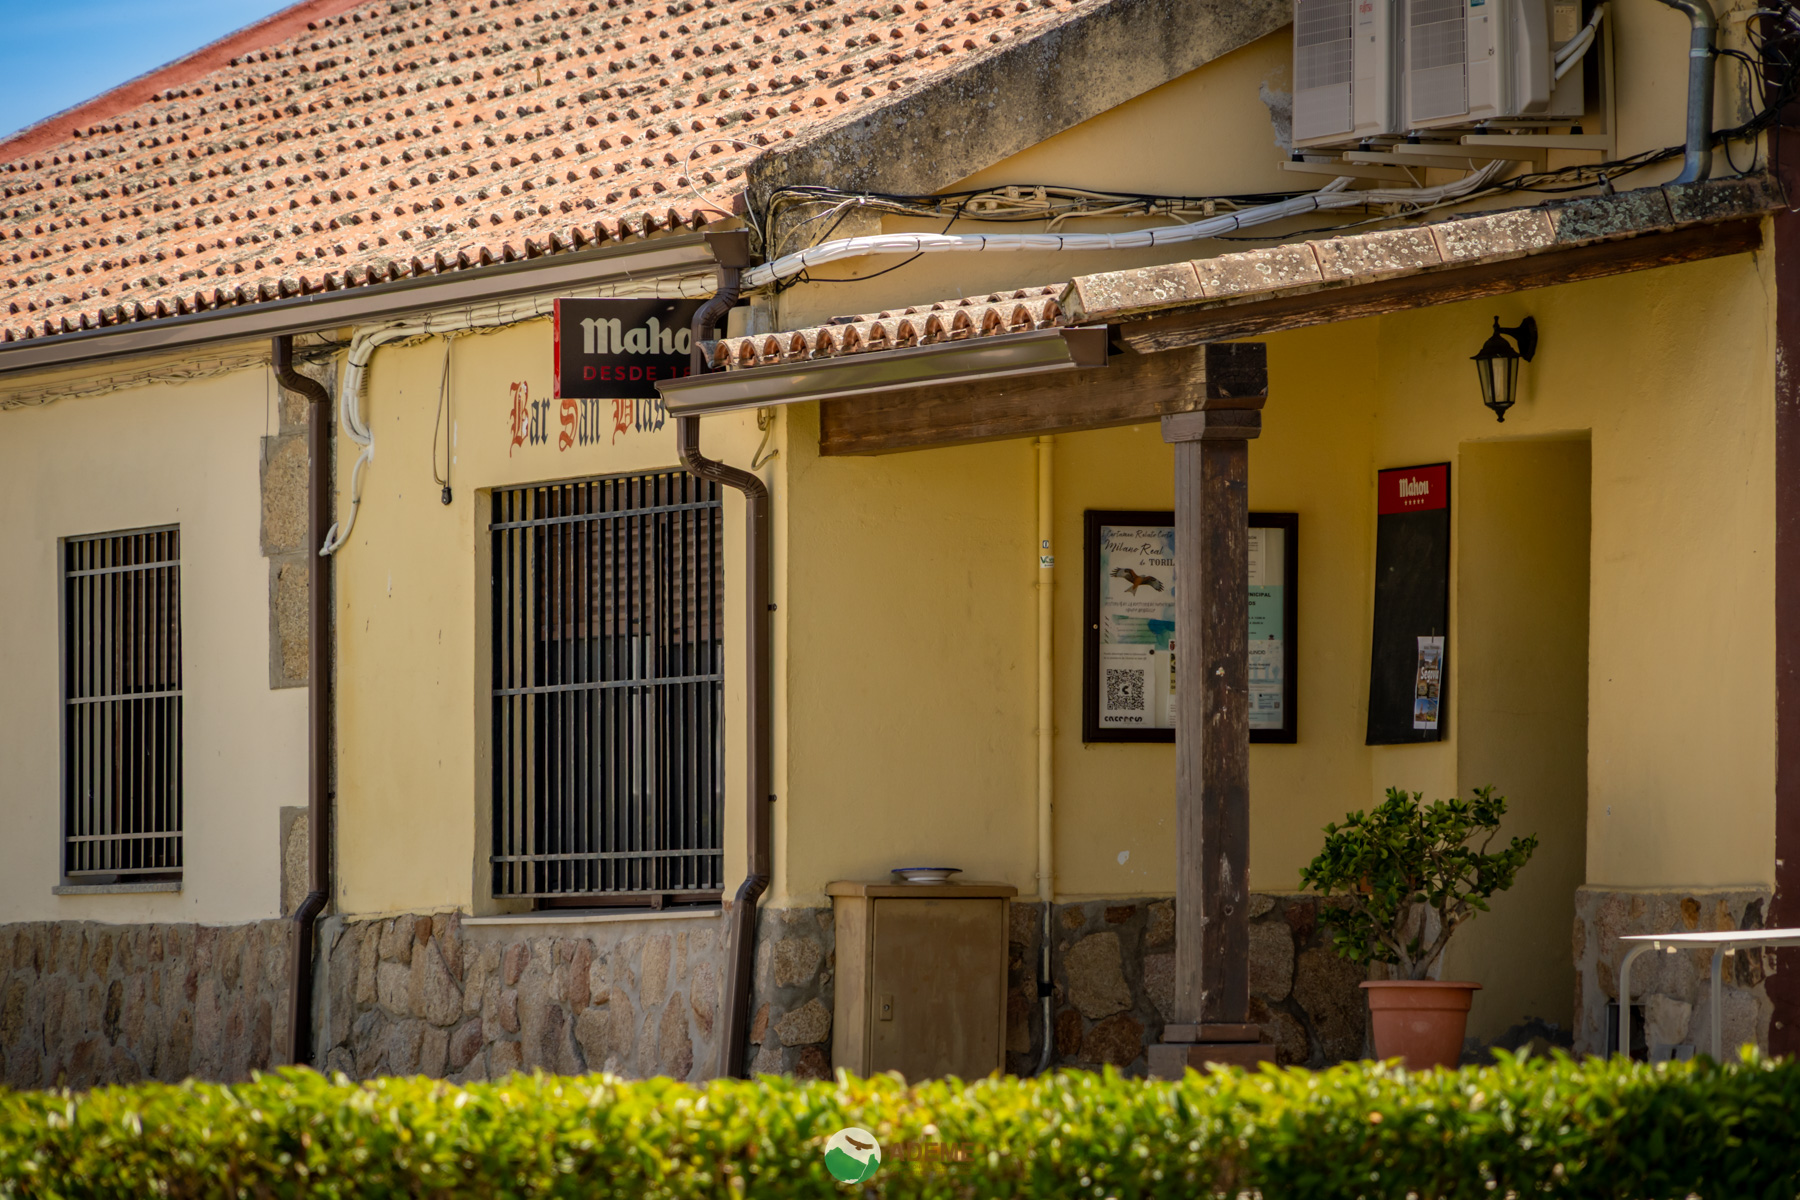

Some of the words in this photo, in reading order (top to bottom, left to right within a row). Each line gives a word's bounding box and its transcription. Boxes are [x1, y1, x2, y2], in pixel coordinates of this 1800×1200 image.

[580, 316, 722, 355] Maho
[584, 366, 657, 381] DESDE
[509, 380, 551, 458] Bar
[558, 398, 601, 453] San
[1398, 476, 1430, 498] Mahou
[1104, 539, 1139, 553] Milano
[1139, 543, 1164, 556] Real
